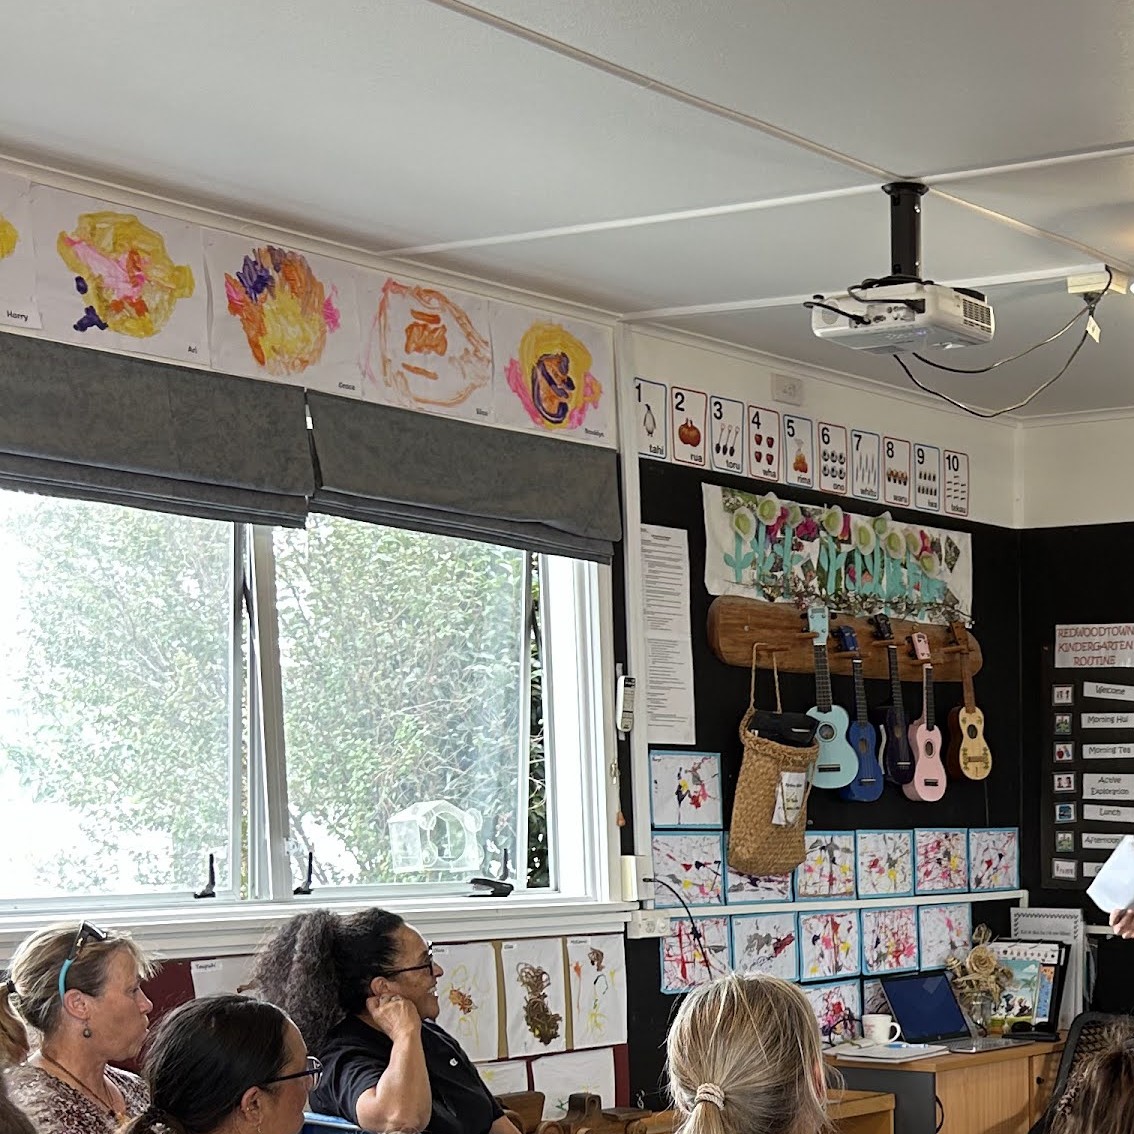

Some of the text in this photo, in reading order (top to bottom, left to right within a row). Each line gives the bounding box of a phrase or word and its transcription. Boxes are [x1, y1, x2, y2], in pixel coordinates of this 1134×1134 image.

[6, 310, 28, 322] Harry
[635, 384, 642, 402] 1
[675, 392, 685, 412] 2
[713, 401, 723, 420] 3
[752, 412, 762, 429] 4
[786, 420, 796, 438] 5
[821, 427, 830, 445] 6
[649, 444, 664, 454] tahi
[854, 434, 862, 451] 7
[886, 442, 894, 458] 8
[917, 448, 925, 464] 9
[690, 454, 702, 462] rua
[726, 460, 740, 470] toru
[946, 454, 959, 472] 10
[1056, 625, 1134, 638] REDWOODTOWN
[1058, 640, 1134, 652] KINDERGARTEN
[1073, 655, 1116, 667] ROUTINE
[1088, 716, 1115, 724] Morning
[1089, 746, 1116, 754] Morning
[1100, 808, 1121, 816] Lunch
